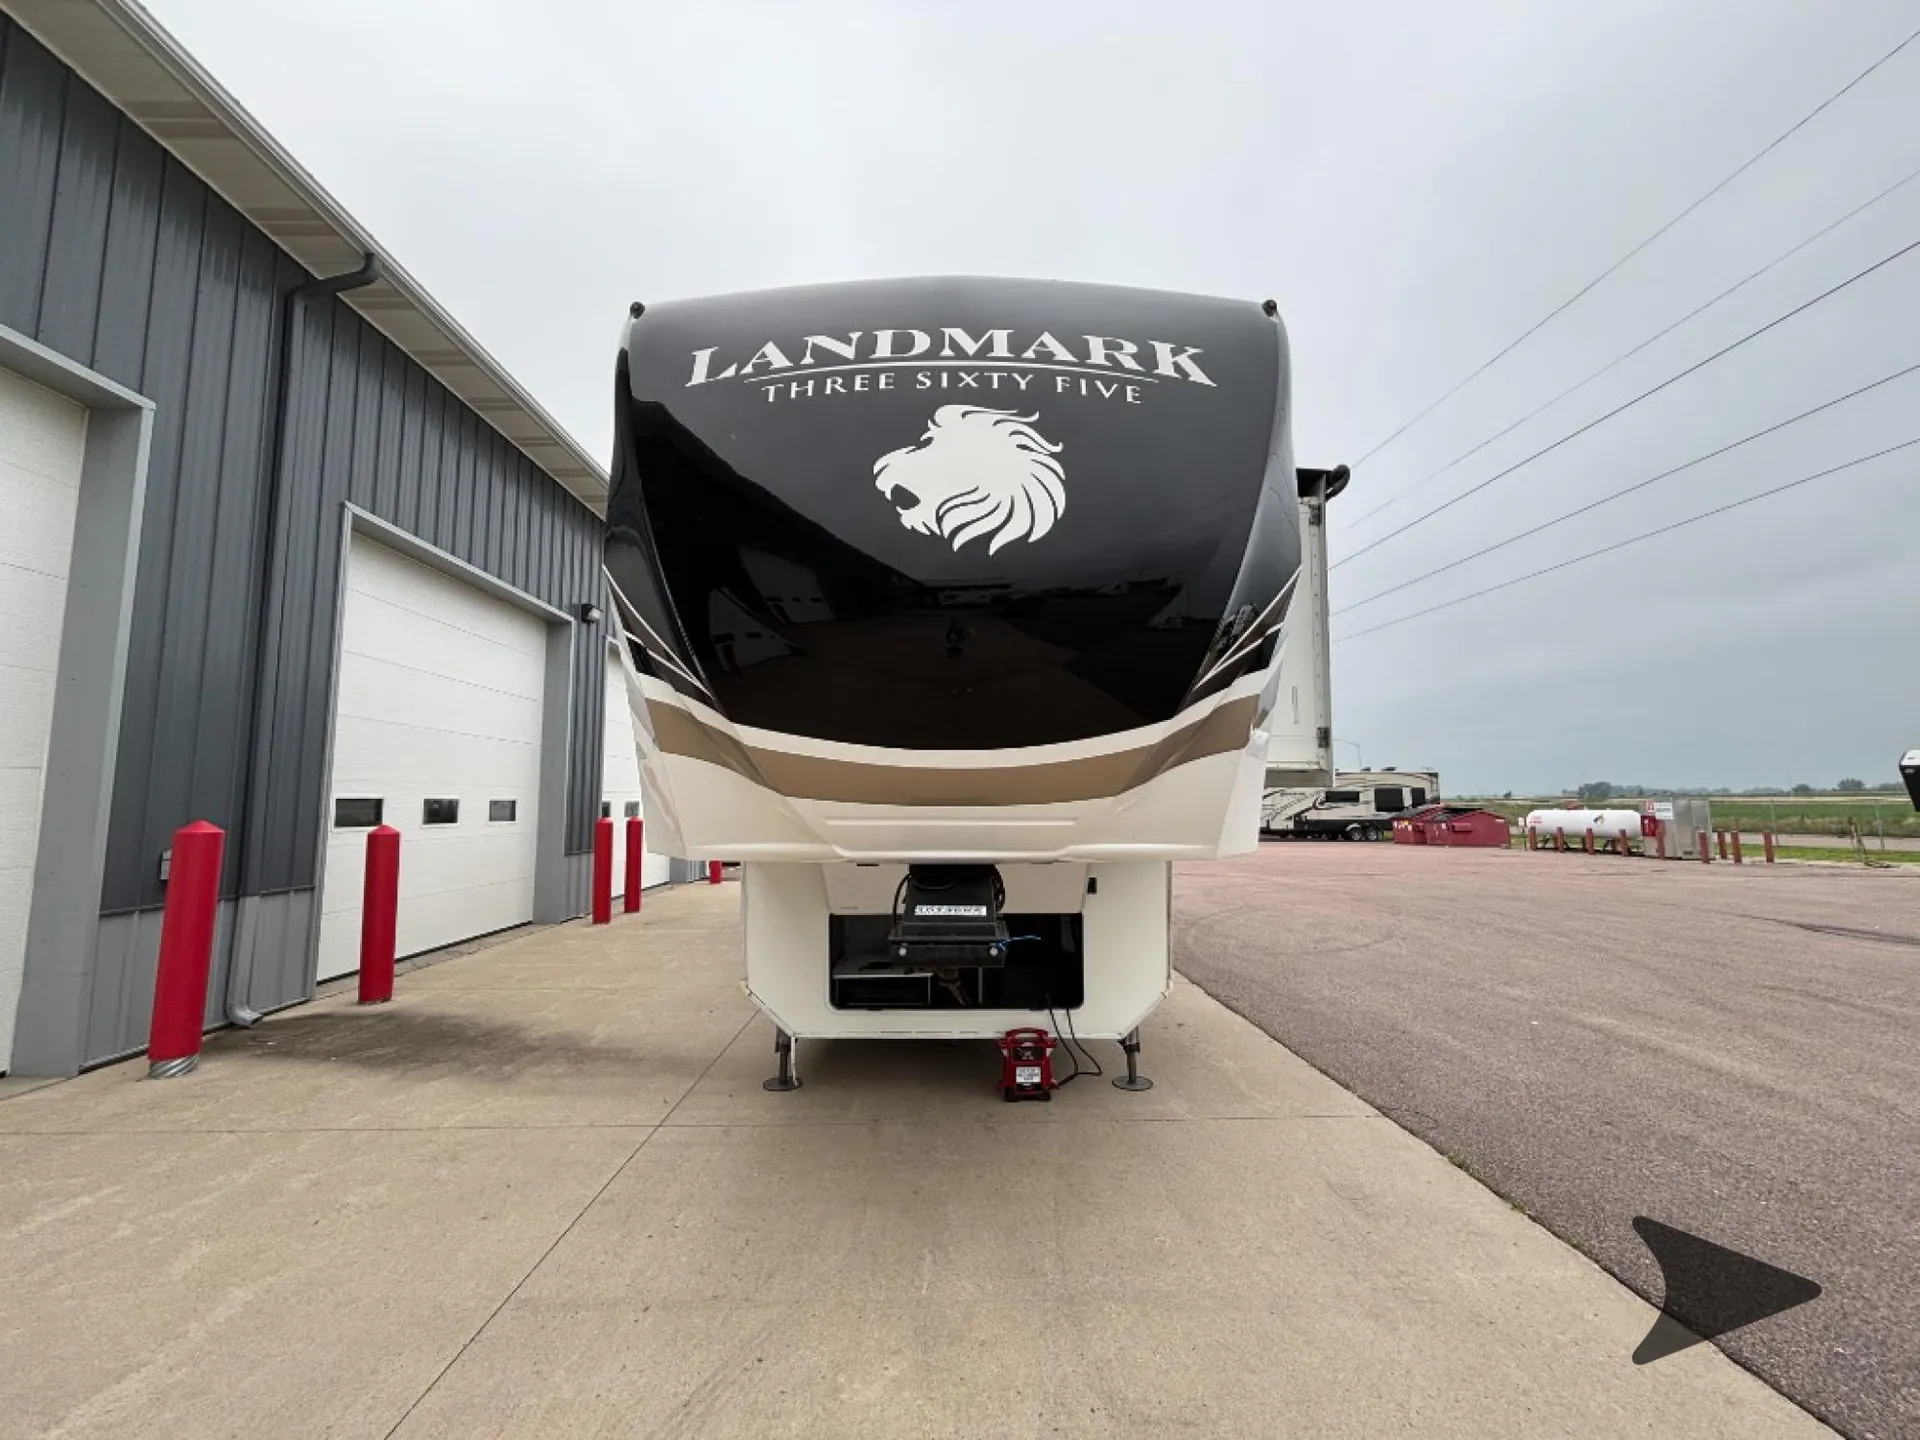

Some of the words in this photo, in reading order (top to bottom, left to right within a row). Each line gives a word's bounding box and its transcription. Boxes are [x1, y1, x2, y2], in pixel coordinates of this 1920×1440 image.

[685, 327, 1217, 388] LANDMARK
[761, 372, 895, 402] THREE
[916, 371, 1033, 390] SIXTY
[1056, 377, 1141, 404] FIVE
